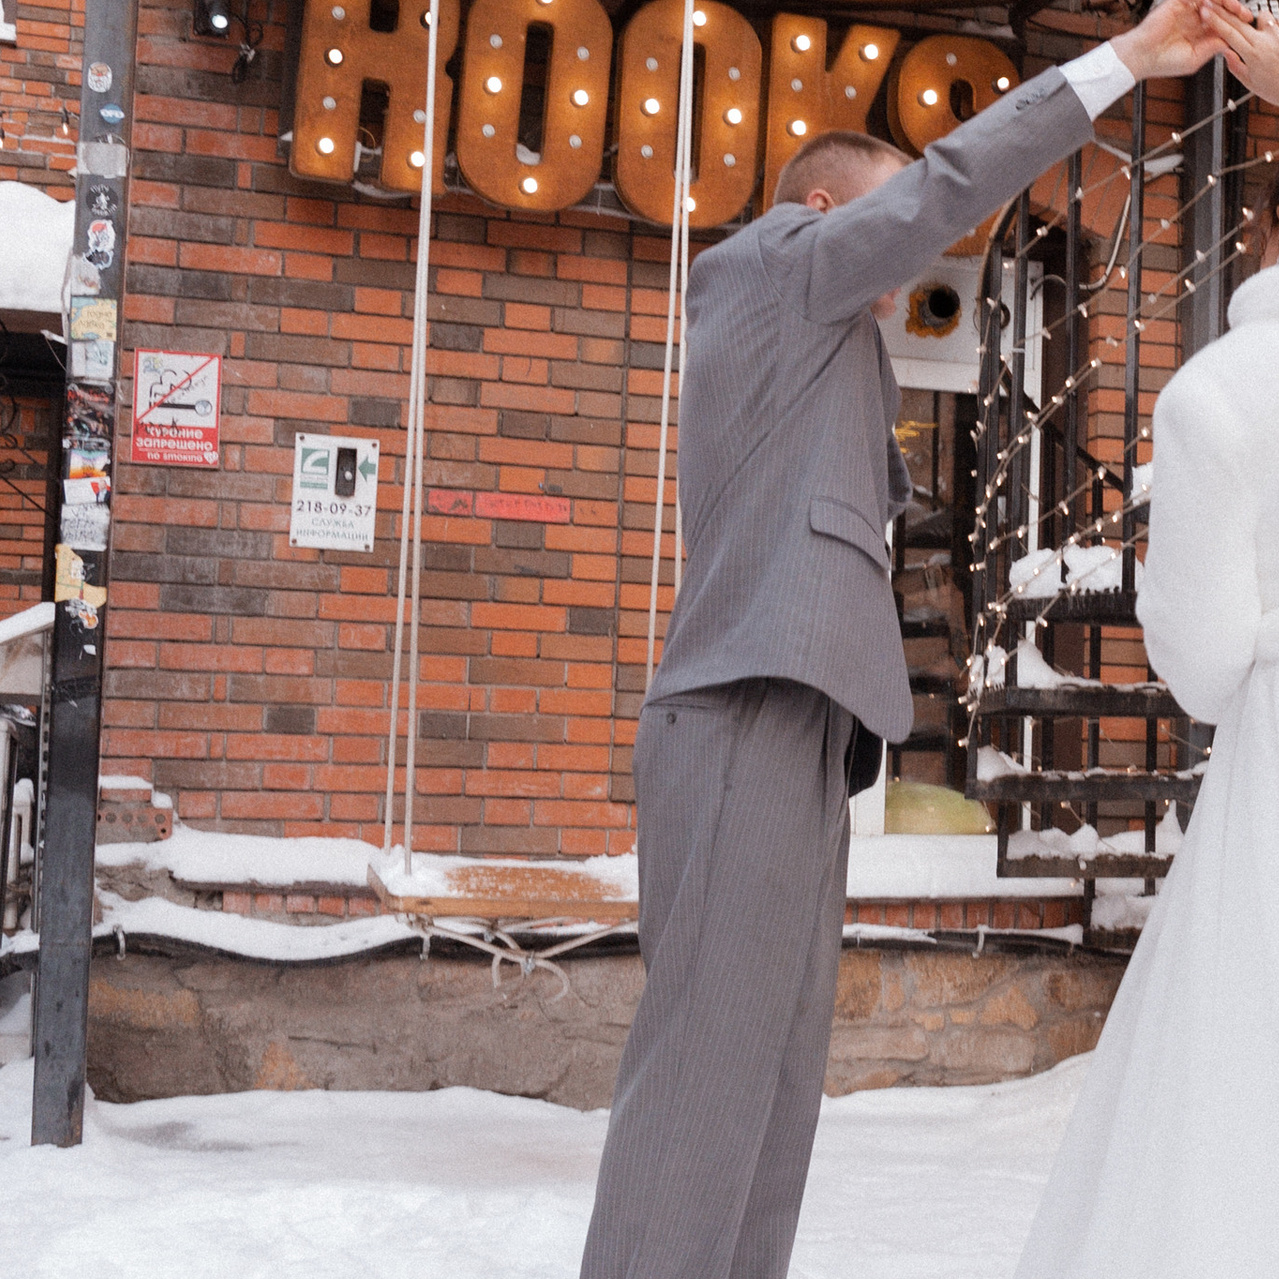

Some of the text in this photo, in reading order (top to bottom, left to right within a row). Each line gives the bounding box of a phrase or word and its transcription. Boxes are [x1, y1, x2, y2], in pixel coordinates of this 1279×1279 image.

[147, 452, 160, 460] no
[297, 500, 371, 517] 218-09-37
[312, 518, 354, 528] СЛУЖБА
[296, 528, 369, 541] ИНФОРМАЦИИ
